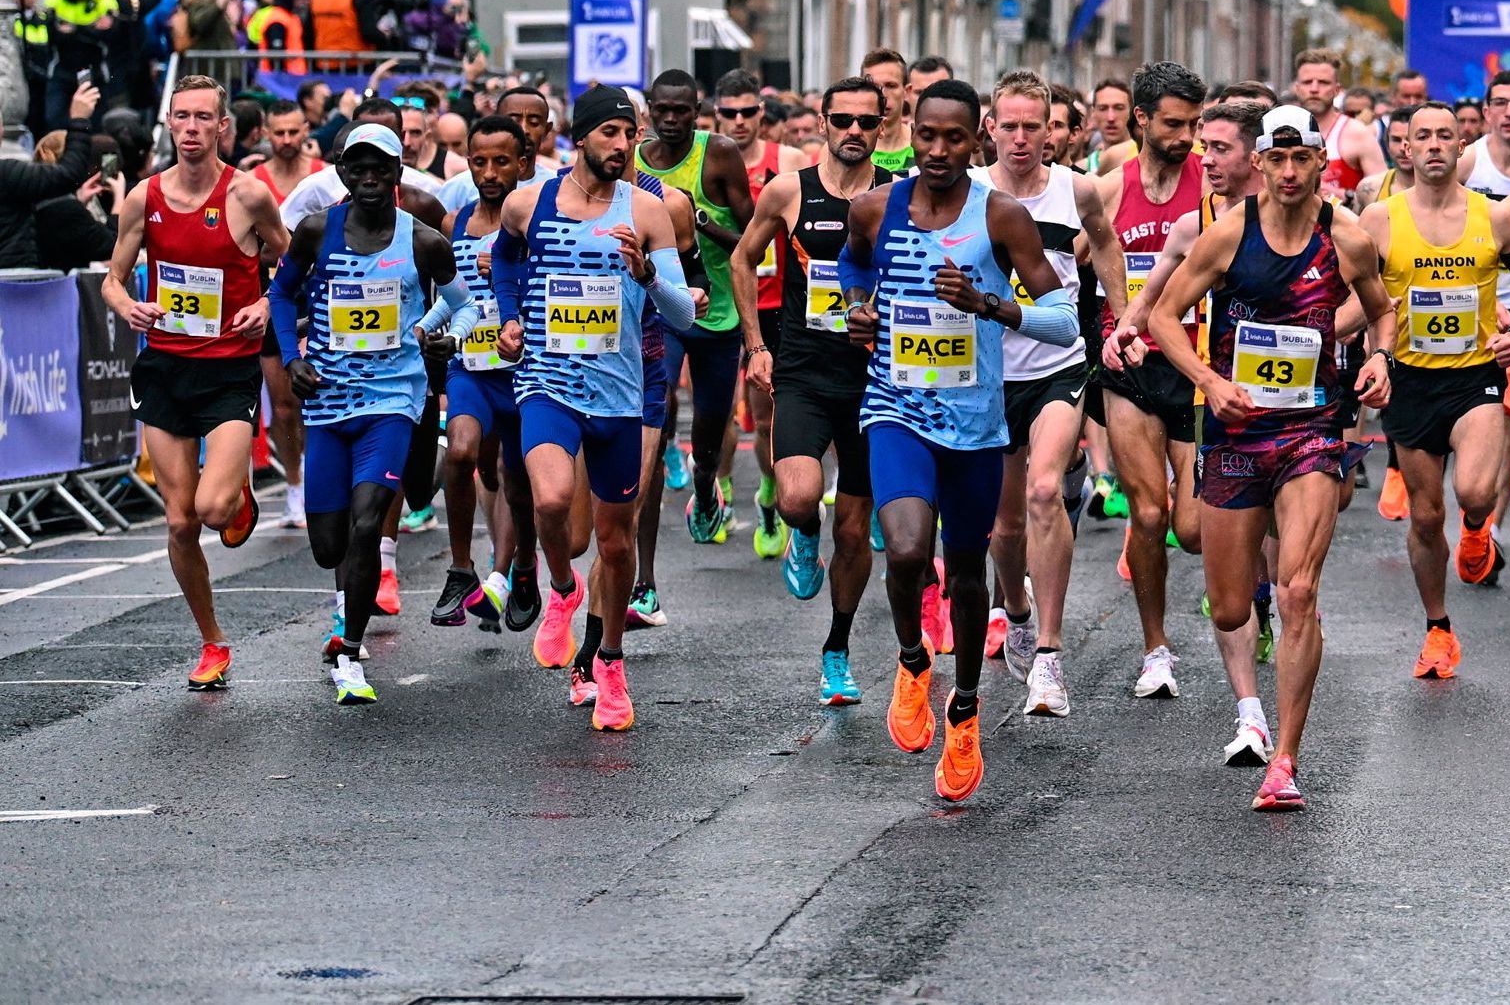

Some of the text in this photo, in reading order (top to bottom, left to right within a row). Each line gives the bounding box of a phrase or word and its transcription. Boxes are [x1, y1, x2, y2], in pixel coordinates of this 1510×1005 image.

[1122, 221, 1156, 245] EAST
[1414, 257, 1475, 268] BANDON
[1431, 270, 1460, 280] A.C.
[367, 286, 394, 294] DUBLIN
[170, 294, 200, 315] 33
[349, 310, 380, 330] 32
[549, 308, 616, 323] ALLAM
[935, 312, 968, 320] DUBLIN
[1427, 315, 1460, 335] 68
[900, 336, 966, 356] PACE
[1281, 335, 1313, 344] DUBLIN
[9, 349, 68, 415] Irish Life
[1256, 360, 1294, 384] 43
[1221, 452, 1254, 473] FOX
